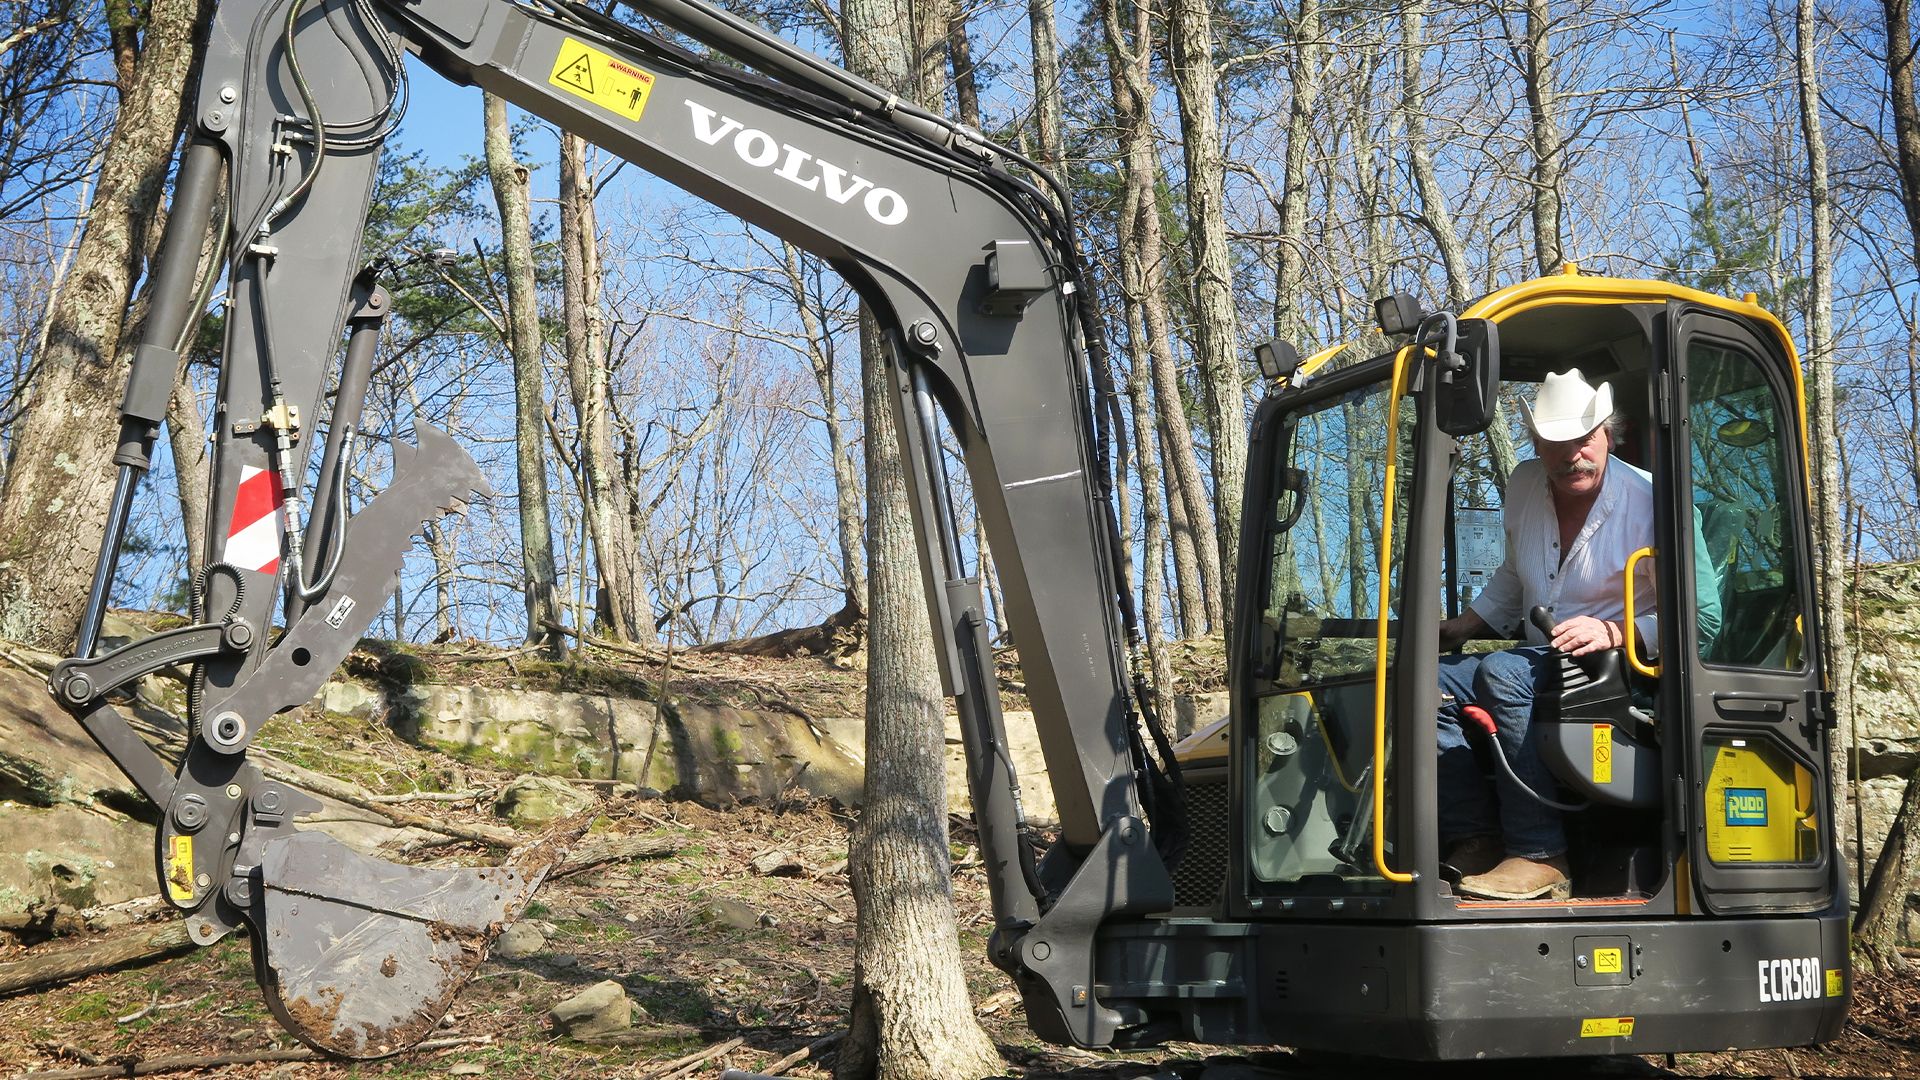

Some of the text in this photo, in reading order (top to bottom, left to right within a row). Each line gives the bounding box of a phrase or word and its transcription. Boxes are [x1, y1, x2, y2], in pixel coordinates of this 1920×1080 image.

[615, 63, 651, 83] WARNING
[684, 99, 908, 226] VOLVO
[1728, 796, 1765, 818] RUDD
[1758, 957, 1821, 1002] ECR58D
